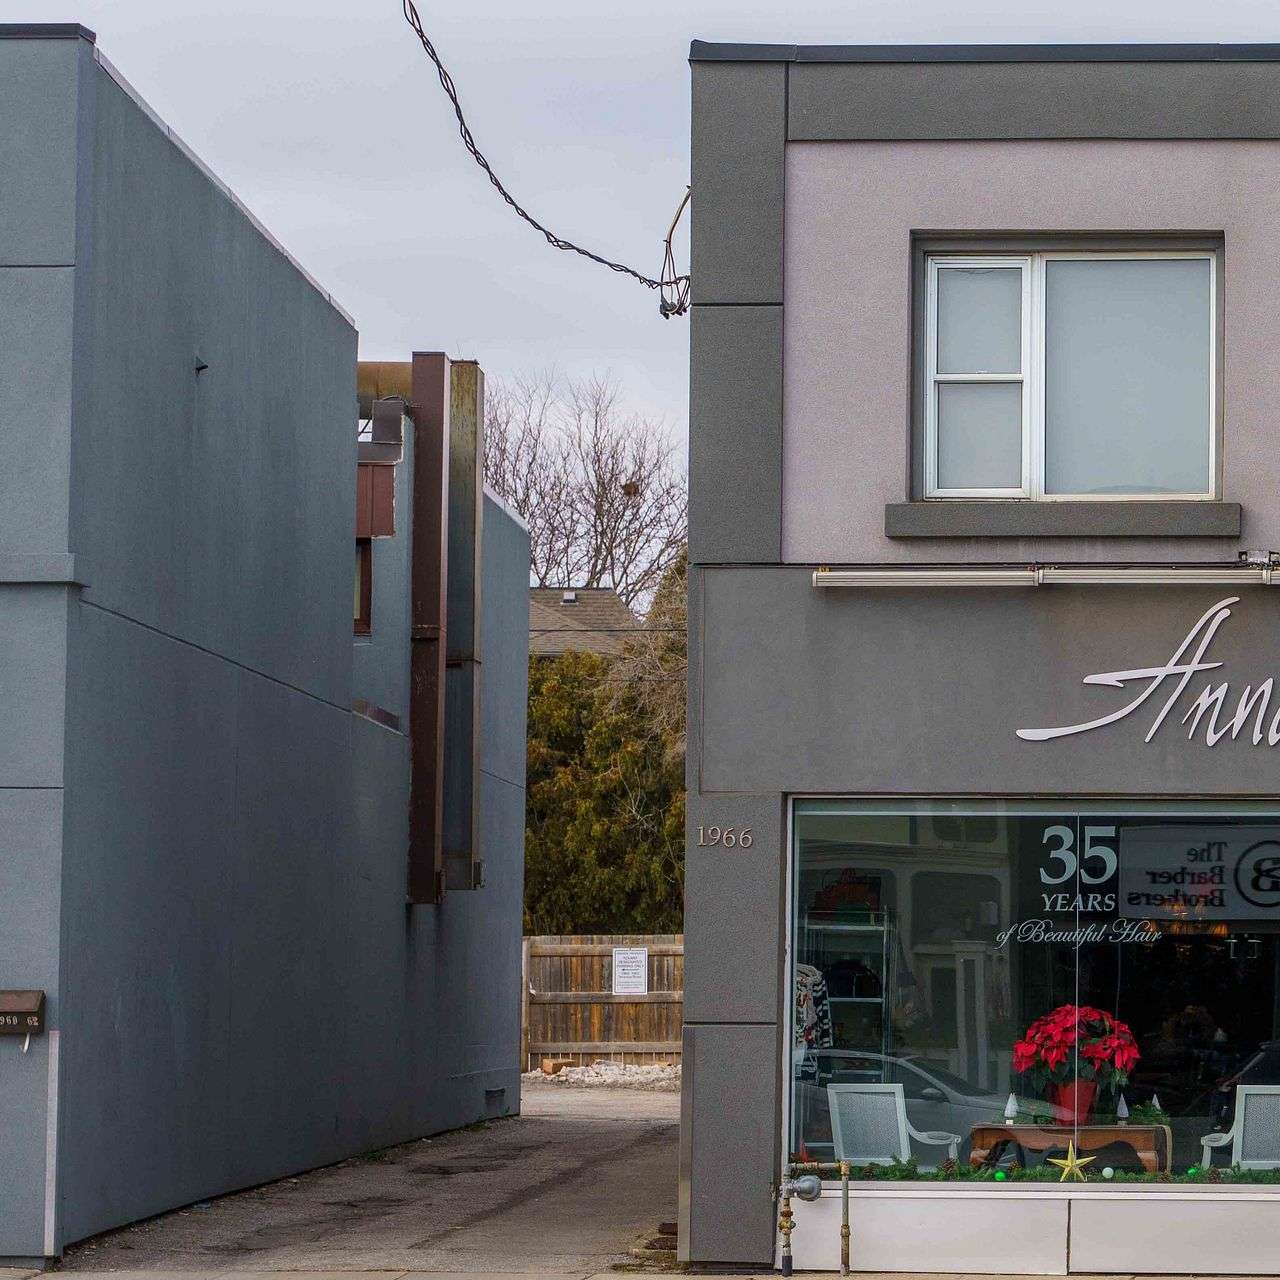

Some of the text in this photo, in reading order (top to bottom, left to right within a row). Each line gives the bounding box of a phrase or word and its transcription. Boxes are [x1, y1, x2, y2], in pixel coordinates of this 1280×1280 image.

[696, 825, 754, 849] 1966
[1039, 825, 1119, 885] 35
[1041, 893, 1117, 912] YEARS
[993, 918, 1163, 950] of Beautiful Hair
